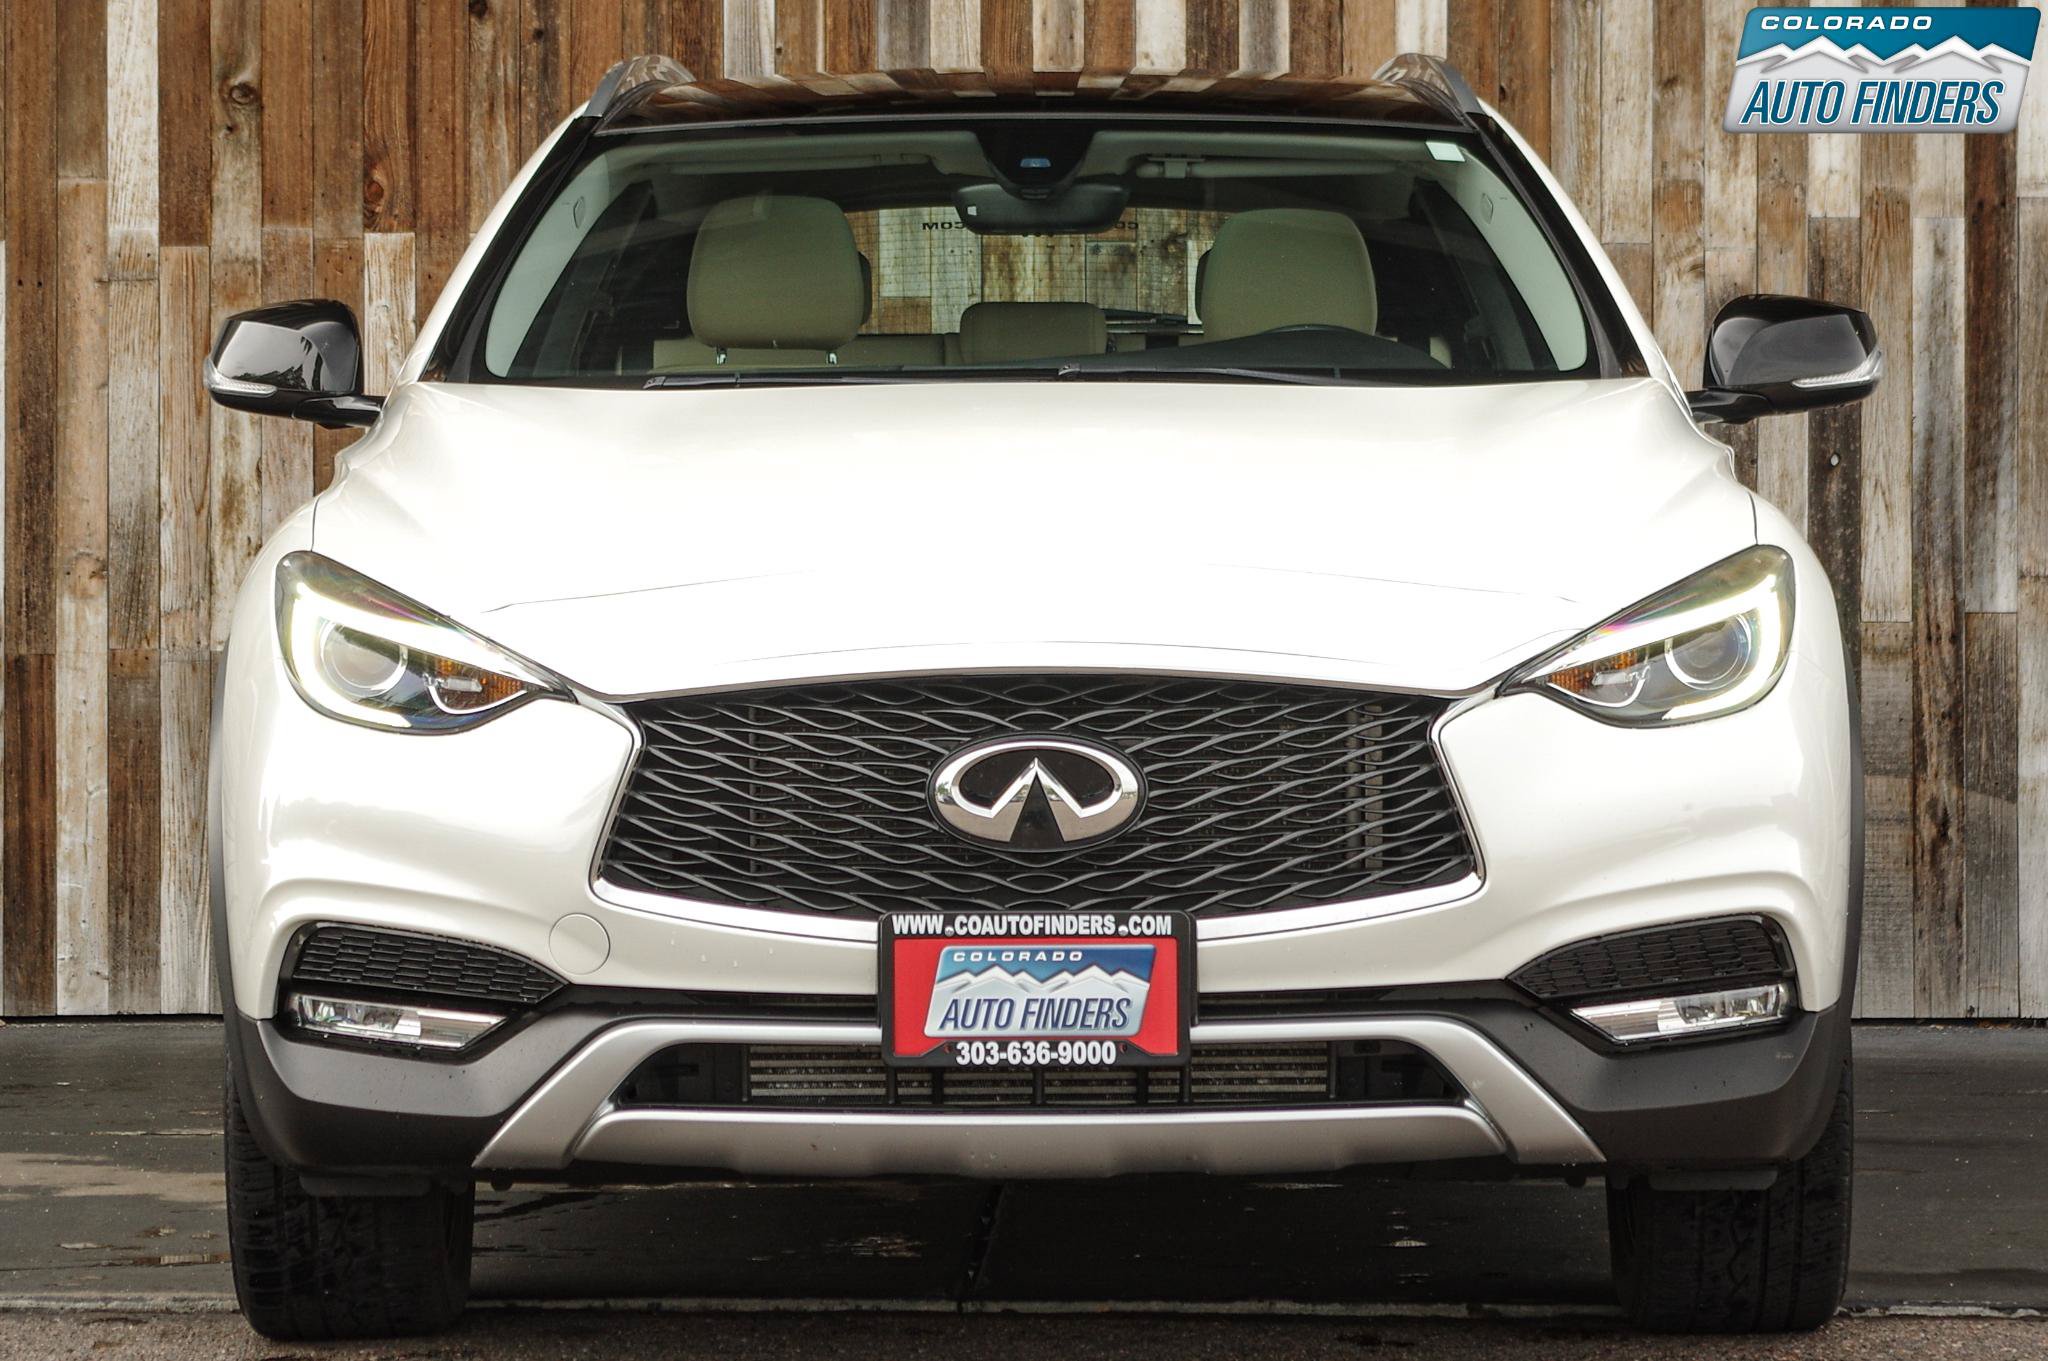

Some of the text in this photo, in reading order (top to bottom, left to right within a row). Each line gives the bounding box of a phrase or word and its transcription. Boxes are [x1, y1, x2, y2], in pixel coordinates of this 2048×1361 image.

[892, 915, 1172, 936] WWW.COAUTOFINDERS.COM
[953, 951, 1084, 962] COLORADO
[938, 998, 1132, 1031] AUTO FINDERS
[956, 1041, 1116, 1065] 303-636-9000
